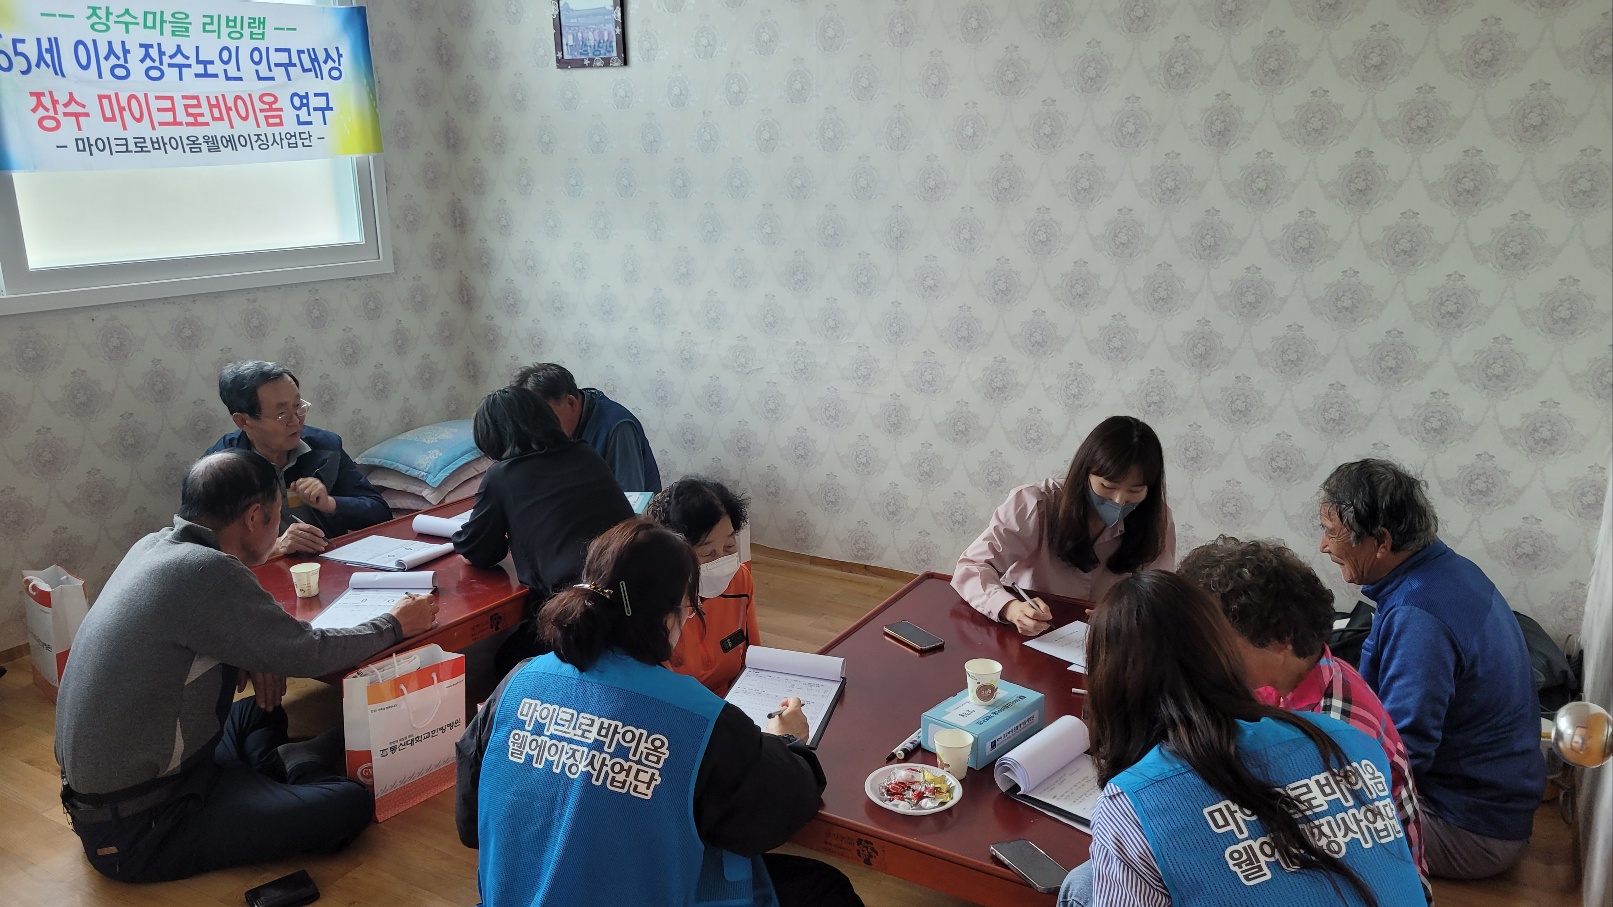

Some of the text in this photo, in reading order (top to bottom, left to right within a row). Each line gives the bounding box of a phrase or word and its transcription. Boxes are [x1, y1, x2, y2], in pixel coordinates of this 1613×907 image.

[85, 5, 267, 41] 장수마을 리빙랩
[73, 38, 131, 81] 이상
[139, 42, 244, 82] 장수노인
[249, 46, 344, 82] 인구대상
[28, 90, 334, 132] 장수 마이크로바이옴 연구
[74, 130, 313, 157] 마이크로바이옴웰에이징사업단
[518, 699, 667, 767] 마이크로바이옴
[509, 731, 660, 798] 웰에이징사업단
[1205, 761, 1388, 837] 마로바이옴
